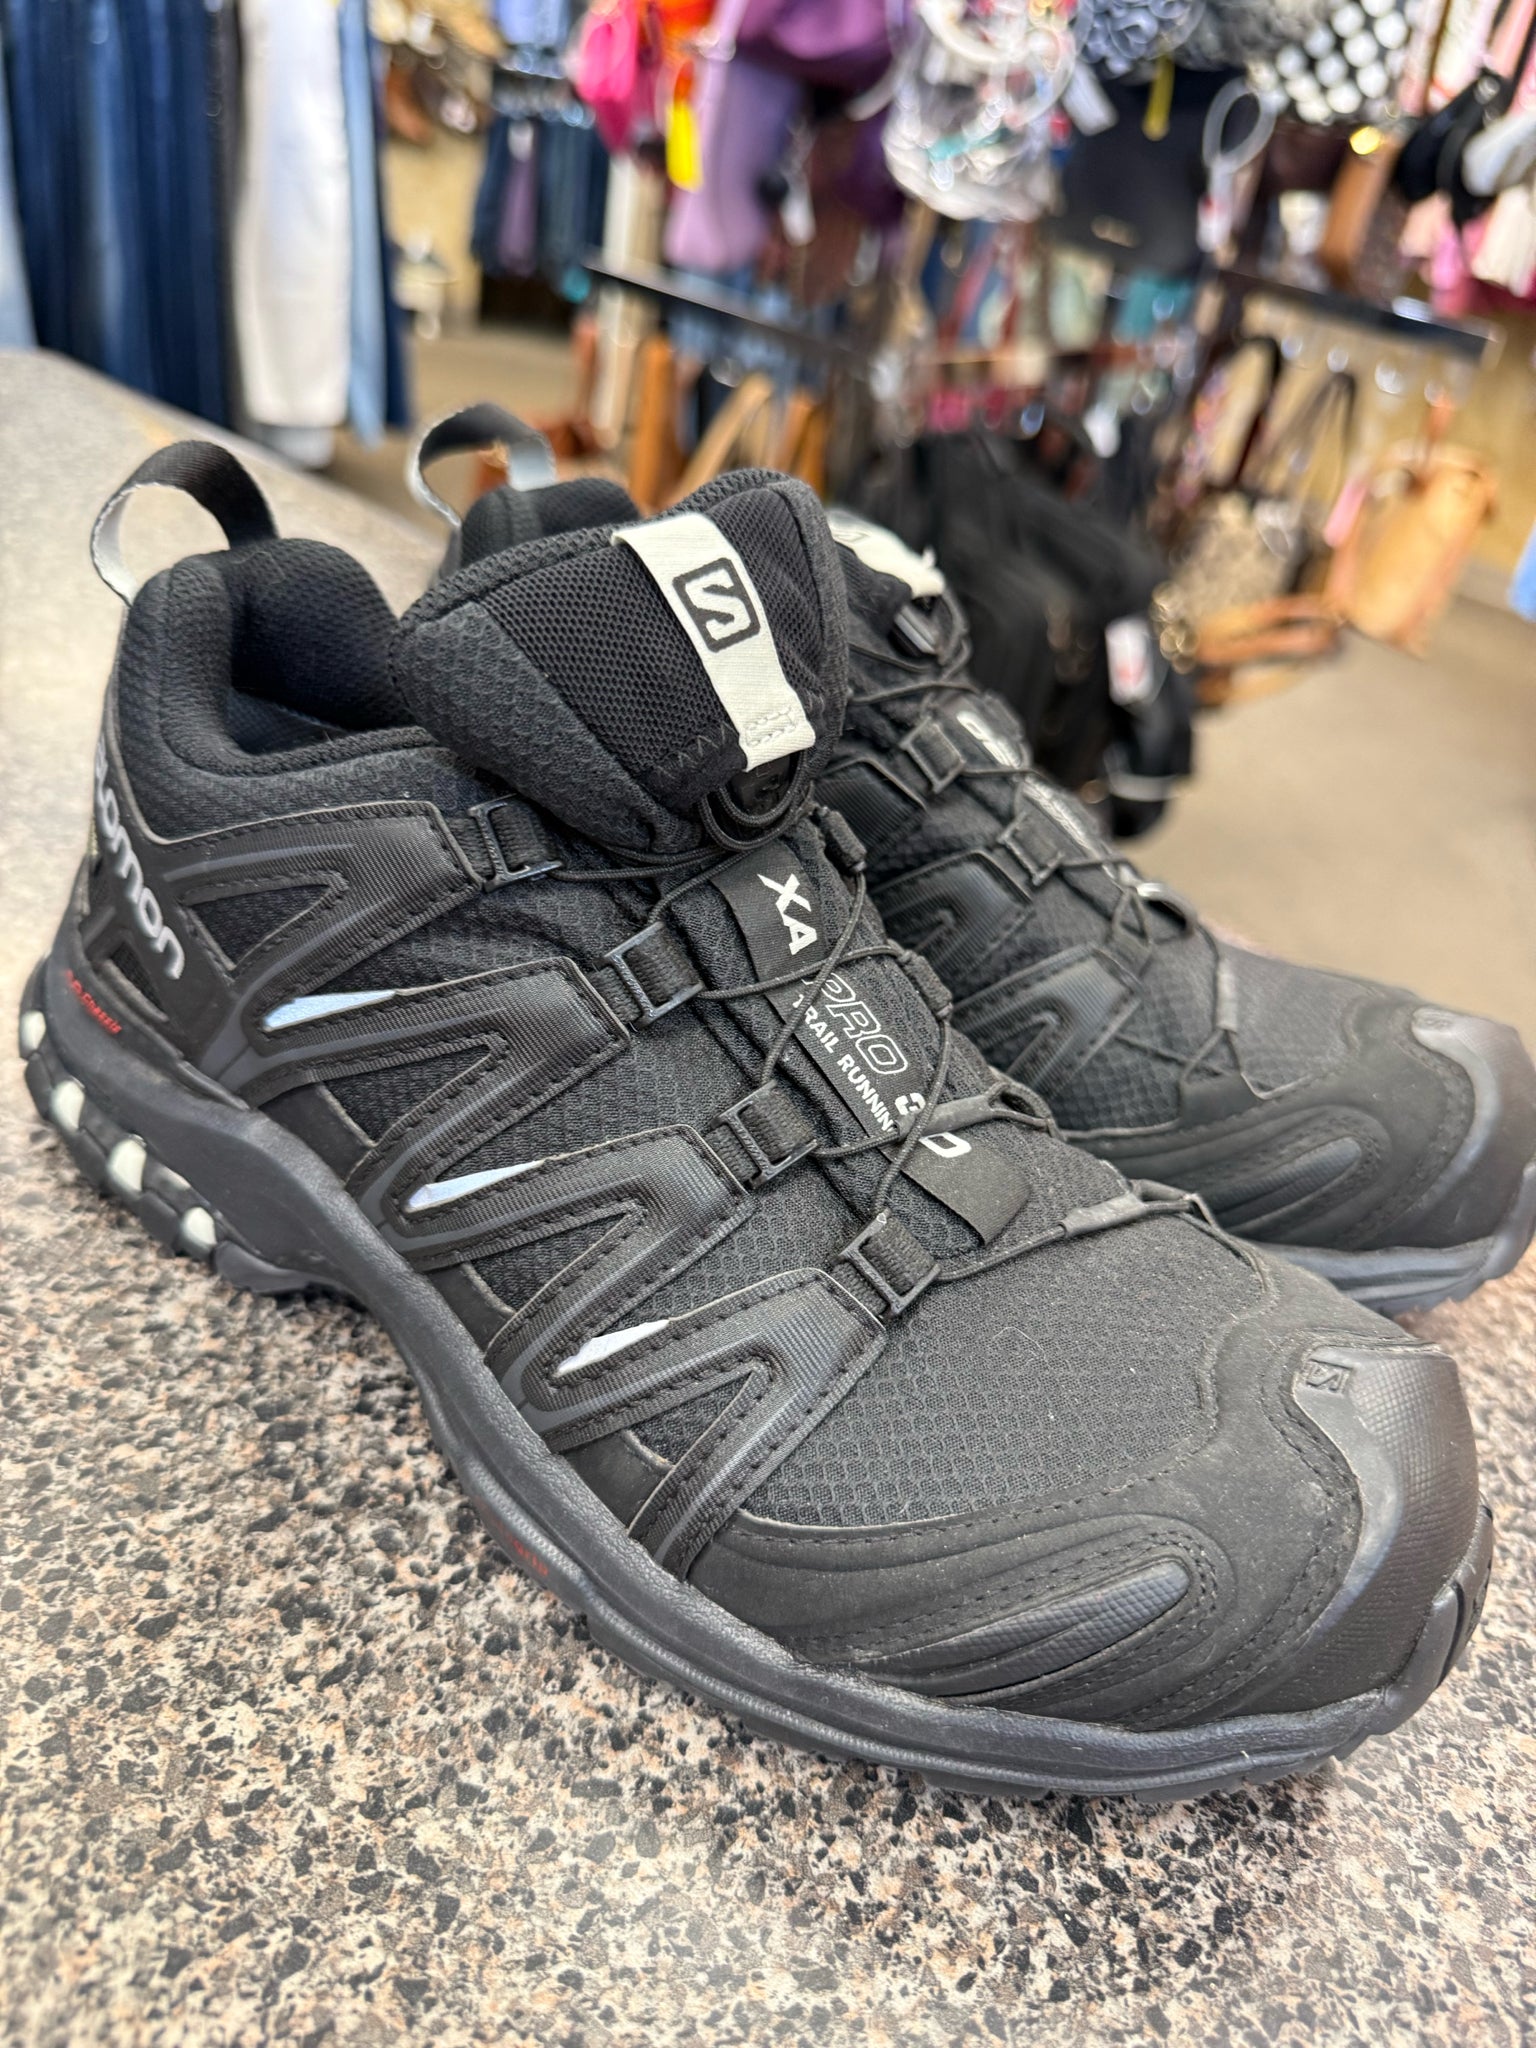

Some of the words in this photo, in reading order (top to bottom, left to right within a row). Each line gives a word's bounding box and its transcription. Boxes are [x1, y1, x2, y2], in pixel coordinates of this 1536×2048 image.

[757, 873, 818, 956] XA
[801, 972, 909, 1075] PRO
[837, 1053, 897, 1133] RUNNIN
